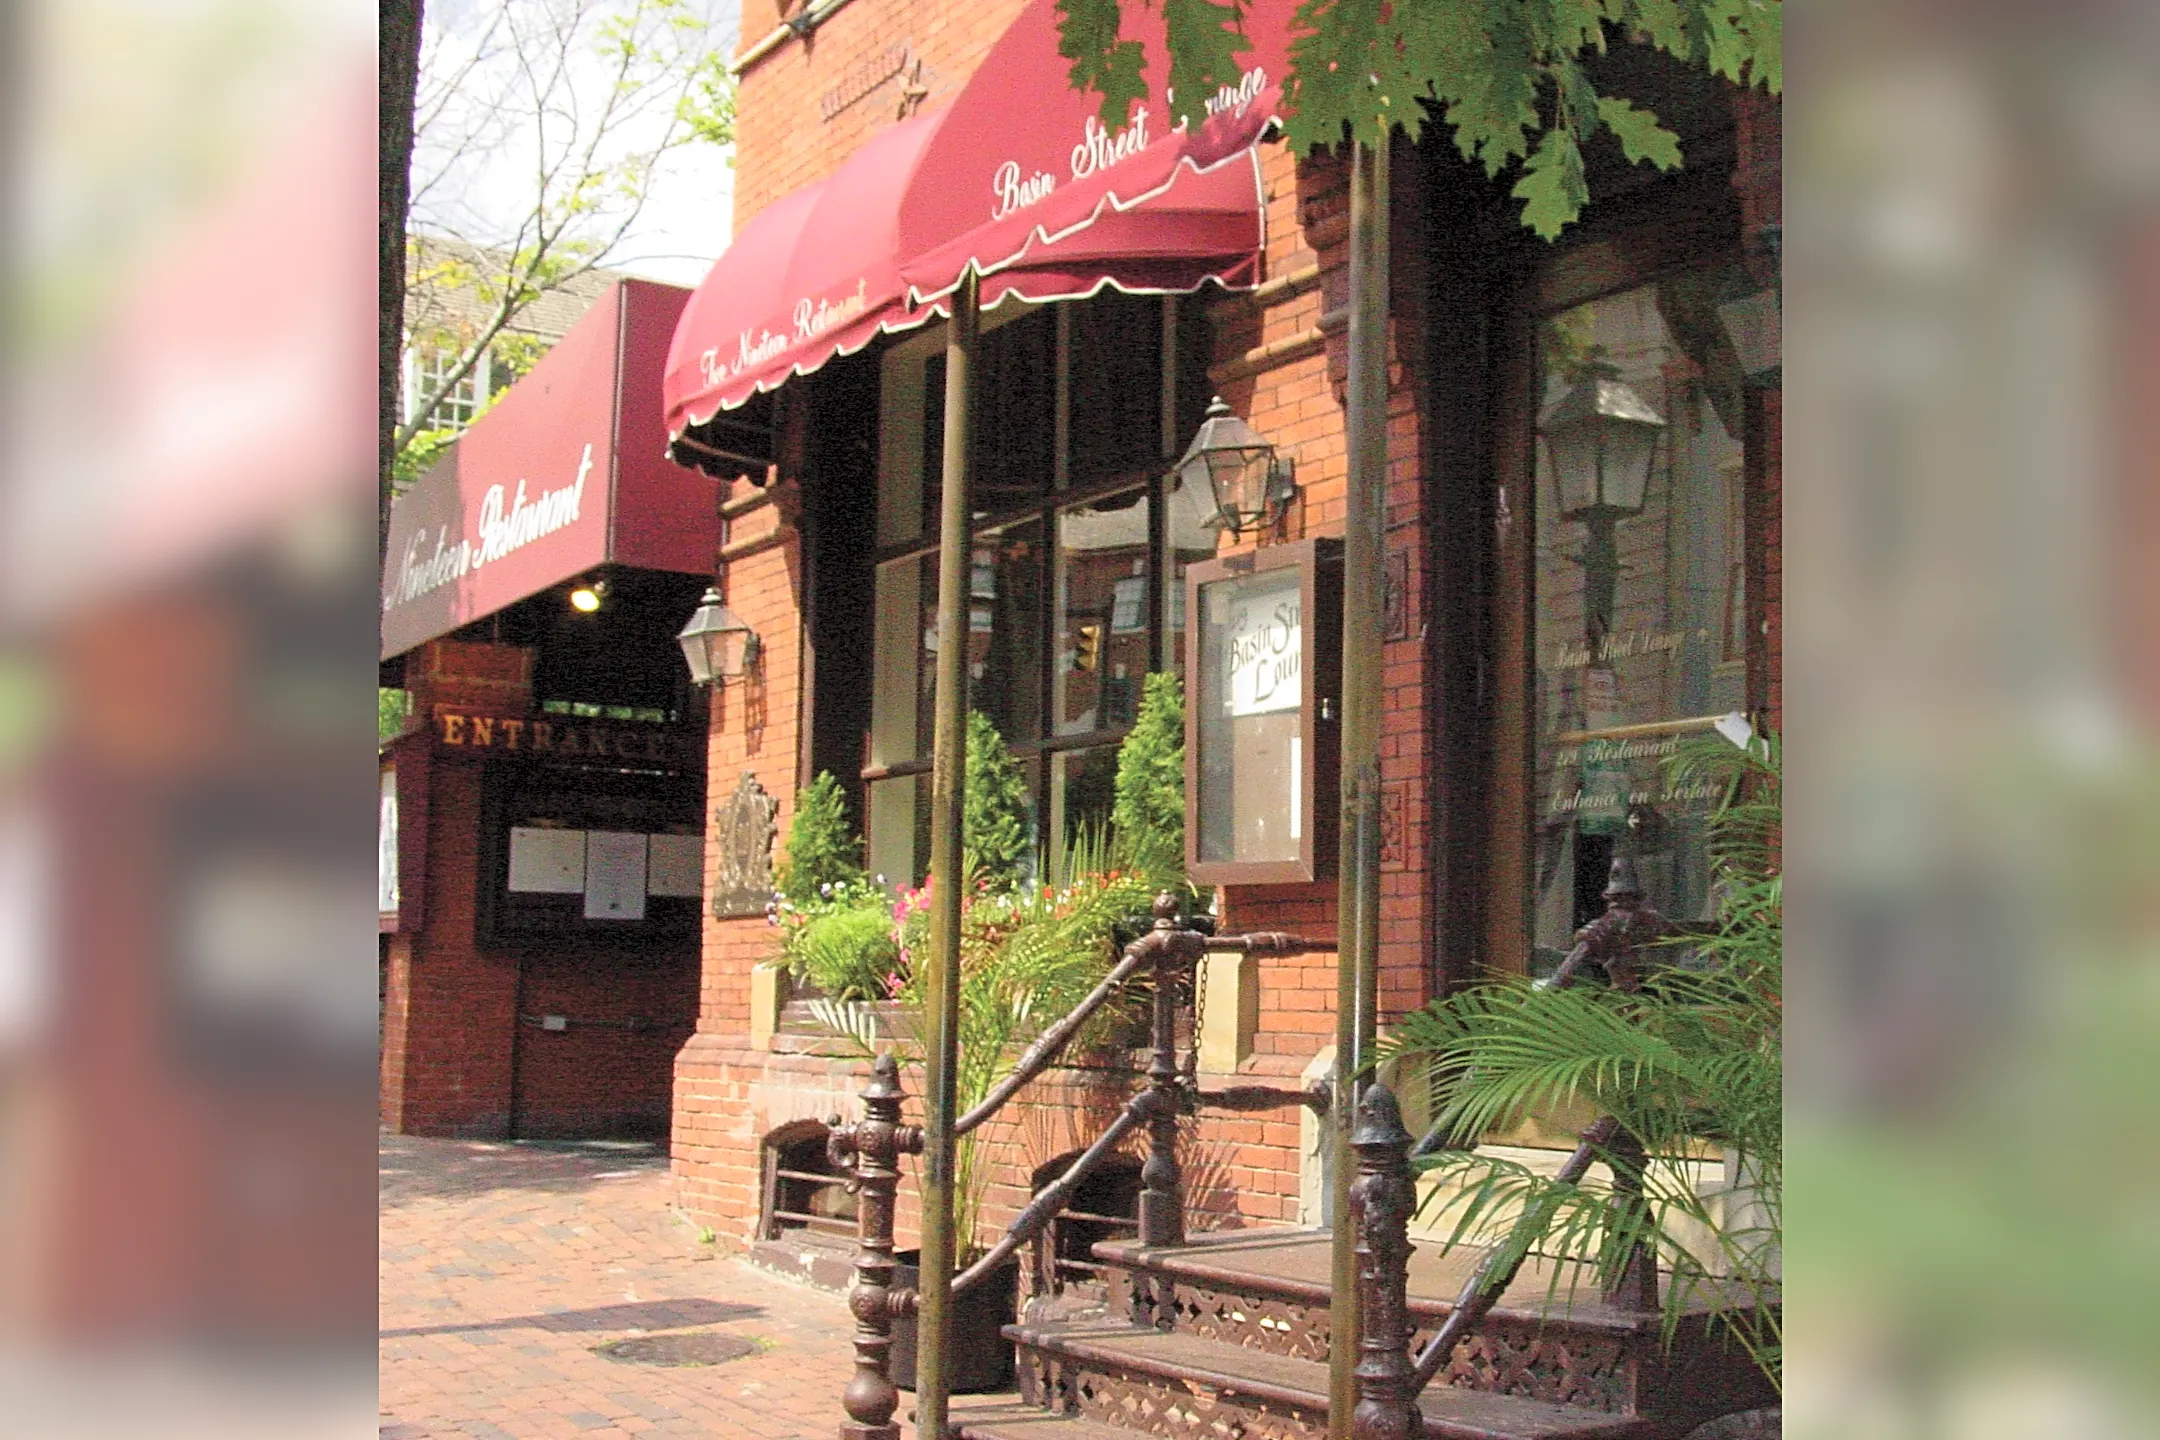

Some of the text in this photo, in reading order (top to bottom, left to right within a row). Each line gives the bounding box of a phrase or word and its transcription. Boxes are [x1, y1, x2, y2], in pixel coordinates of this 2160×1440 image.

[992, 161, 1056, 220] Basin
[1071, 107, 1149, 181] Street
[472, 443, 594, 569] Restaurant
[442, 713, 668, 763] ENTRANCE
[1588, 733, 1680, 764] Restaurant
